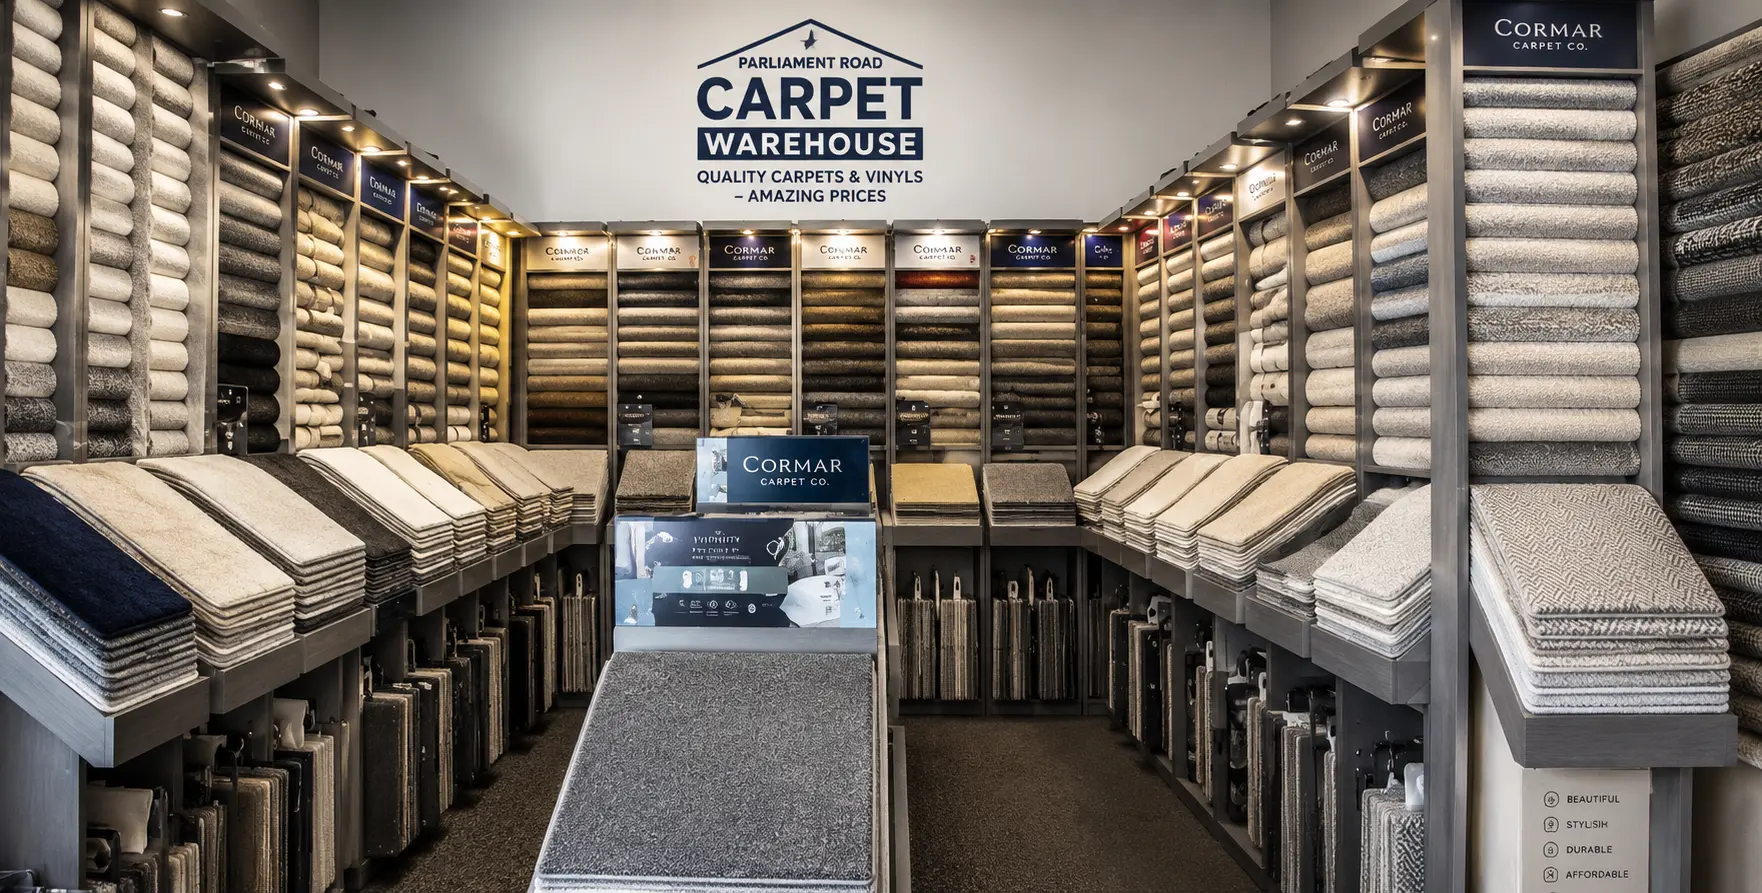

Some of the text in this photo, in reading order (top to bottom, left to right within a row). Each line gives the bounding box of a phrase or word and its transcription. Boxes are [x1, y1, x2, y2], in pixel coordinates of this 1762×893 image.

[1494, 18, 1603, 38] CORMAR
[1513, 42, 1588, 51] CARPET CO.
[738, 56, 883, 69] PARLIAMENT ROAD
[697, 76, 923, 120] CARPET
[1372, 102, 1412, 132] CORMAR
[704, 132, 916, 156] WAREHOUSE
[697, 170, 923, 184] QUALITY CARPETS & VINYLS
[748, 190, 824, 202] AMAZING
[830, 190, 886, 202] PRICES
[724, 244, 775, 254] CORMAR
[1008, 244, 1058, 254] CORMAR
[742, 456, 843, 473] CORMAR
[760, 478, 830, 486] CARPET CO.
[1567, 794, 1620, 804] BEAUTIFUL
[1566, 846, 1612, 854] DURABLE
[1566, 870, 1629, 878] AFFORDABLE
